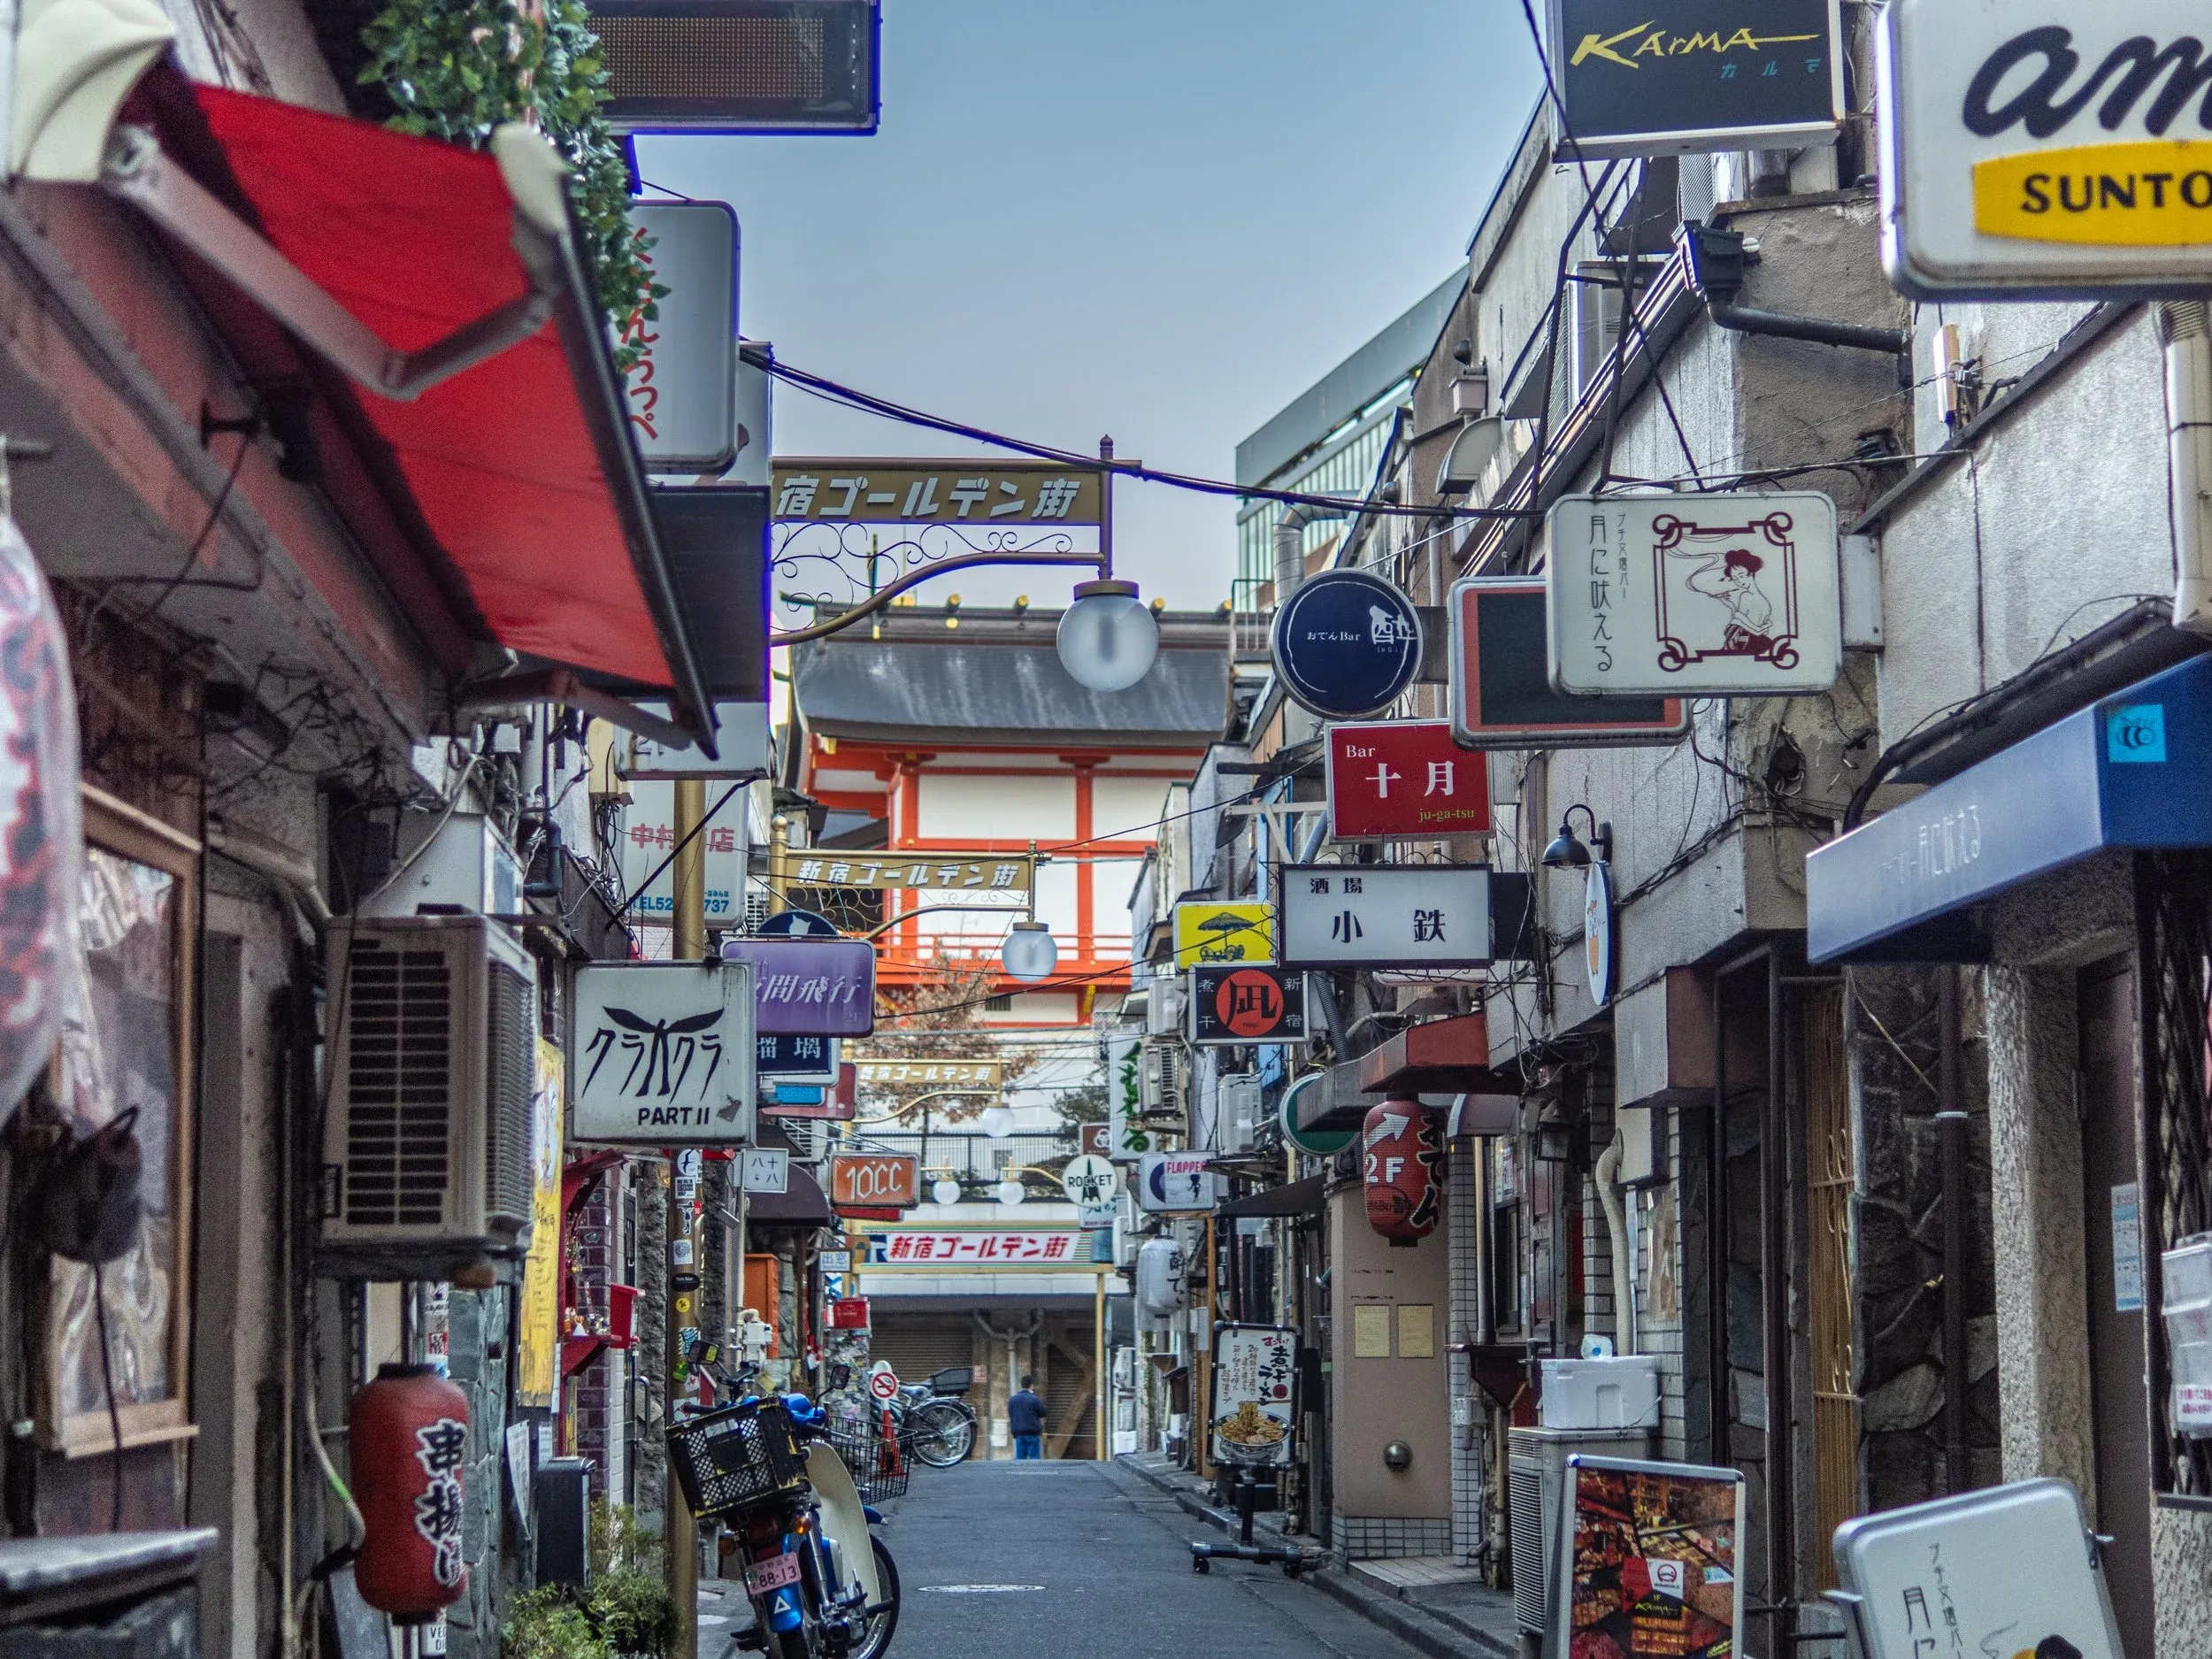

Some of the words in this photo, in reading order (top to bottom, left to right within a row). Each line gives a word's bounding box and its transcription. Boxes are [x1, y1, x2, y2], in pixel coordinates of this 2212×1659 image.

[772, 475, 1081, 518] 宿ゴールデン街
[1590, 515, 1613, 672] 月に吠える
[1340, 631, 1362, 641] Bar
[1346, 744, 1377, 758] Bar
[1365, 760, 1455, 799] 十月
[1417, 809, 1484, 823] ju-ga-tsu
[631, 824, 735, 853] 中村店
[796, 860, 1020, 886] 新宿ゴールデン街
[1310, 877, 1363, 895] 酒場
[1332, 909, 1448, 943] 小鉄
[757, 974, 863, 1004] 間飛行
[638, 1107, 693, 1125] PART
[1068, 1173, 1113, 1188] ROCKET
[1365, 1153, 1405, 1184] 2F
[890, 1236, 1070, 1259] 新宿ゴールデン街
